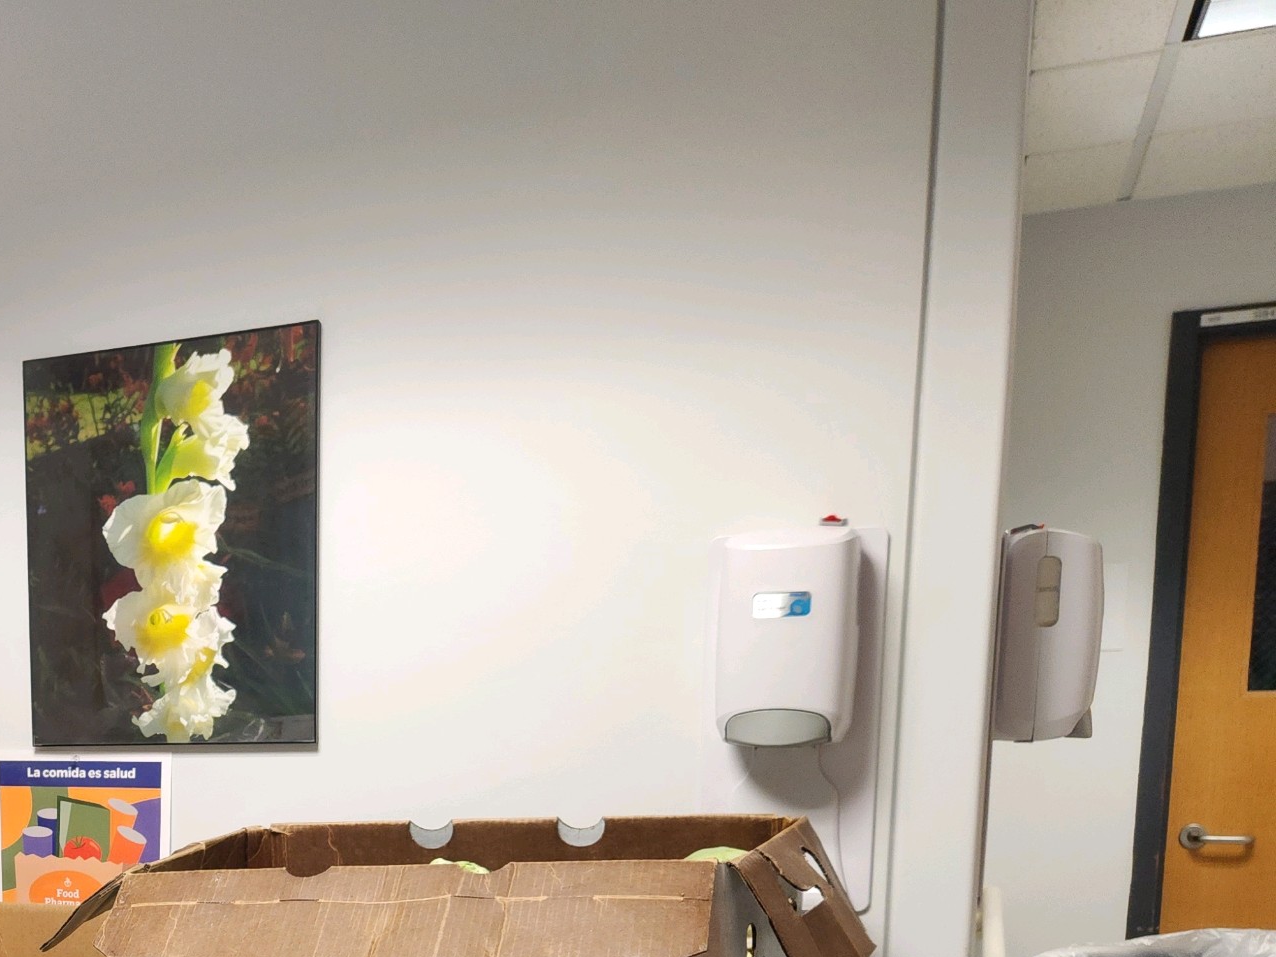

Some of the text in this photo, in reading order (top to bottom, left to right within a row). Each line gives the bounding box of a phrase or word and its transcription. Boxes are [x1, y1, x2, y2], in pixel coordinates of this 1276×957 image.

[27, 767, 136, 780] La comida es salud
[56, 888, 80, 898] Food
